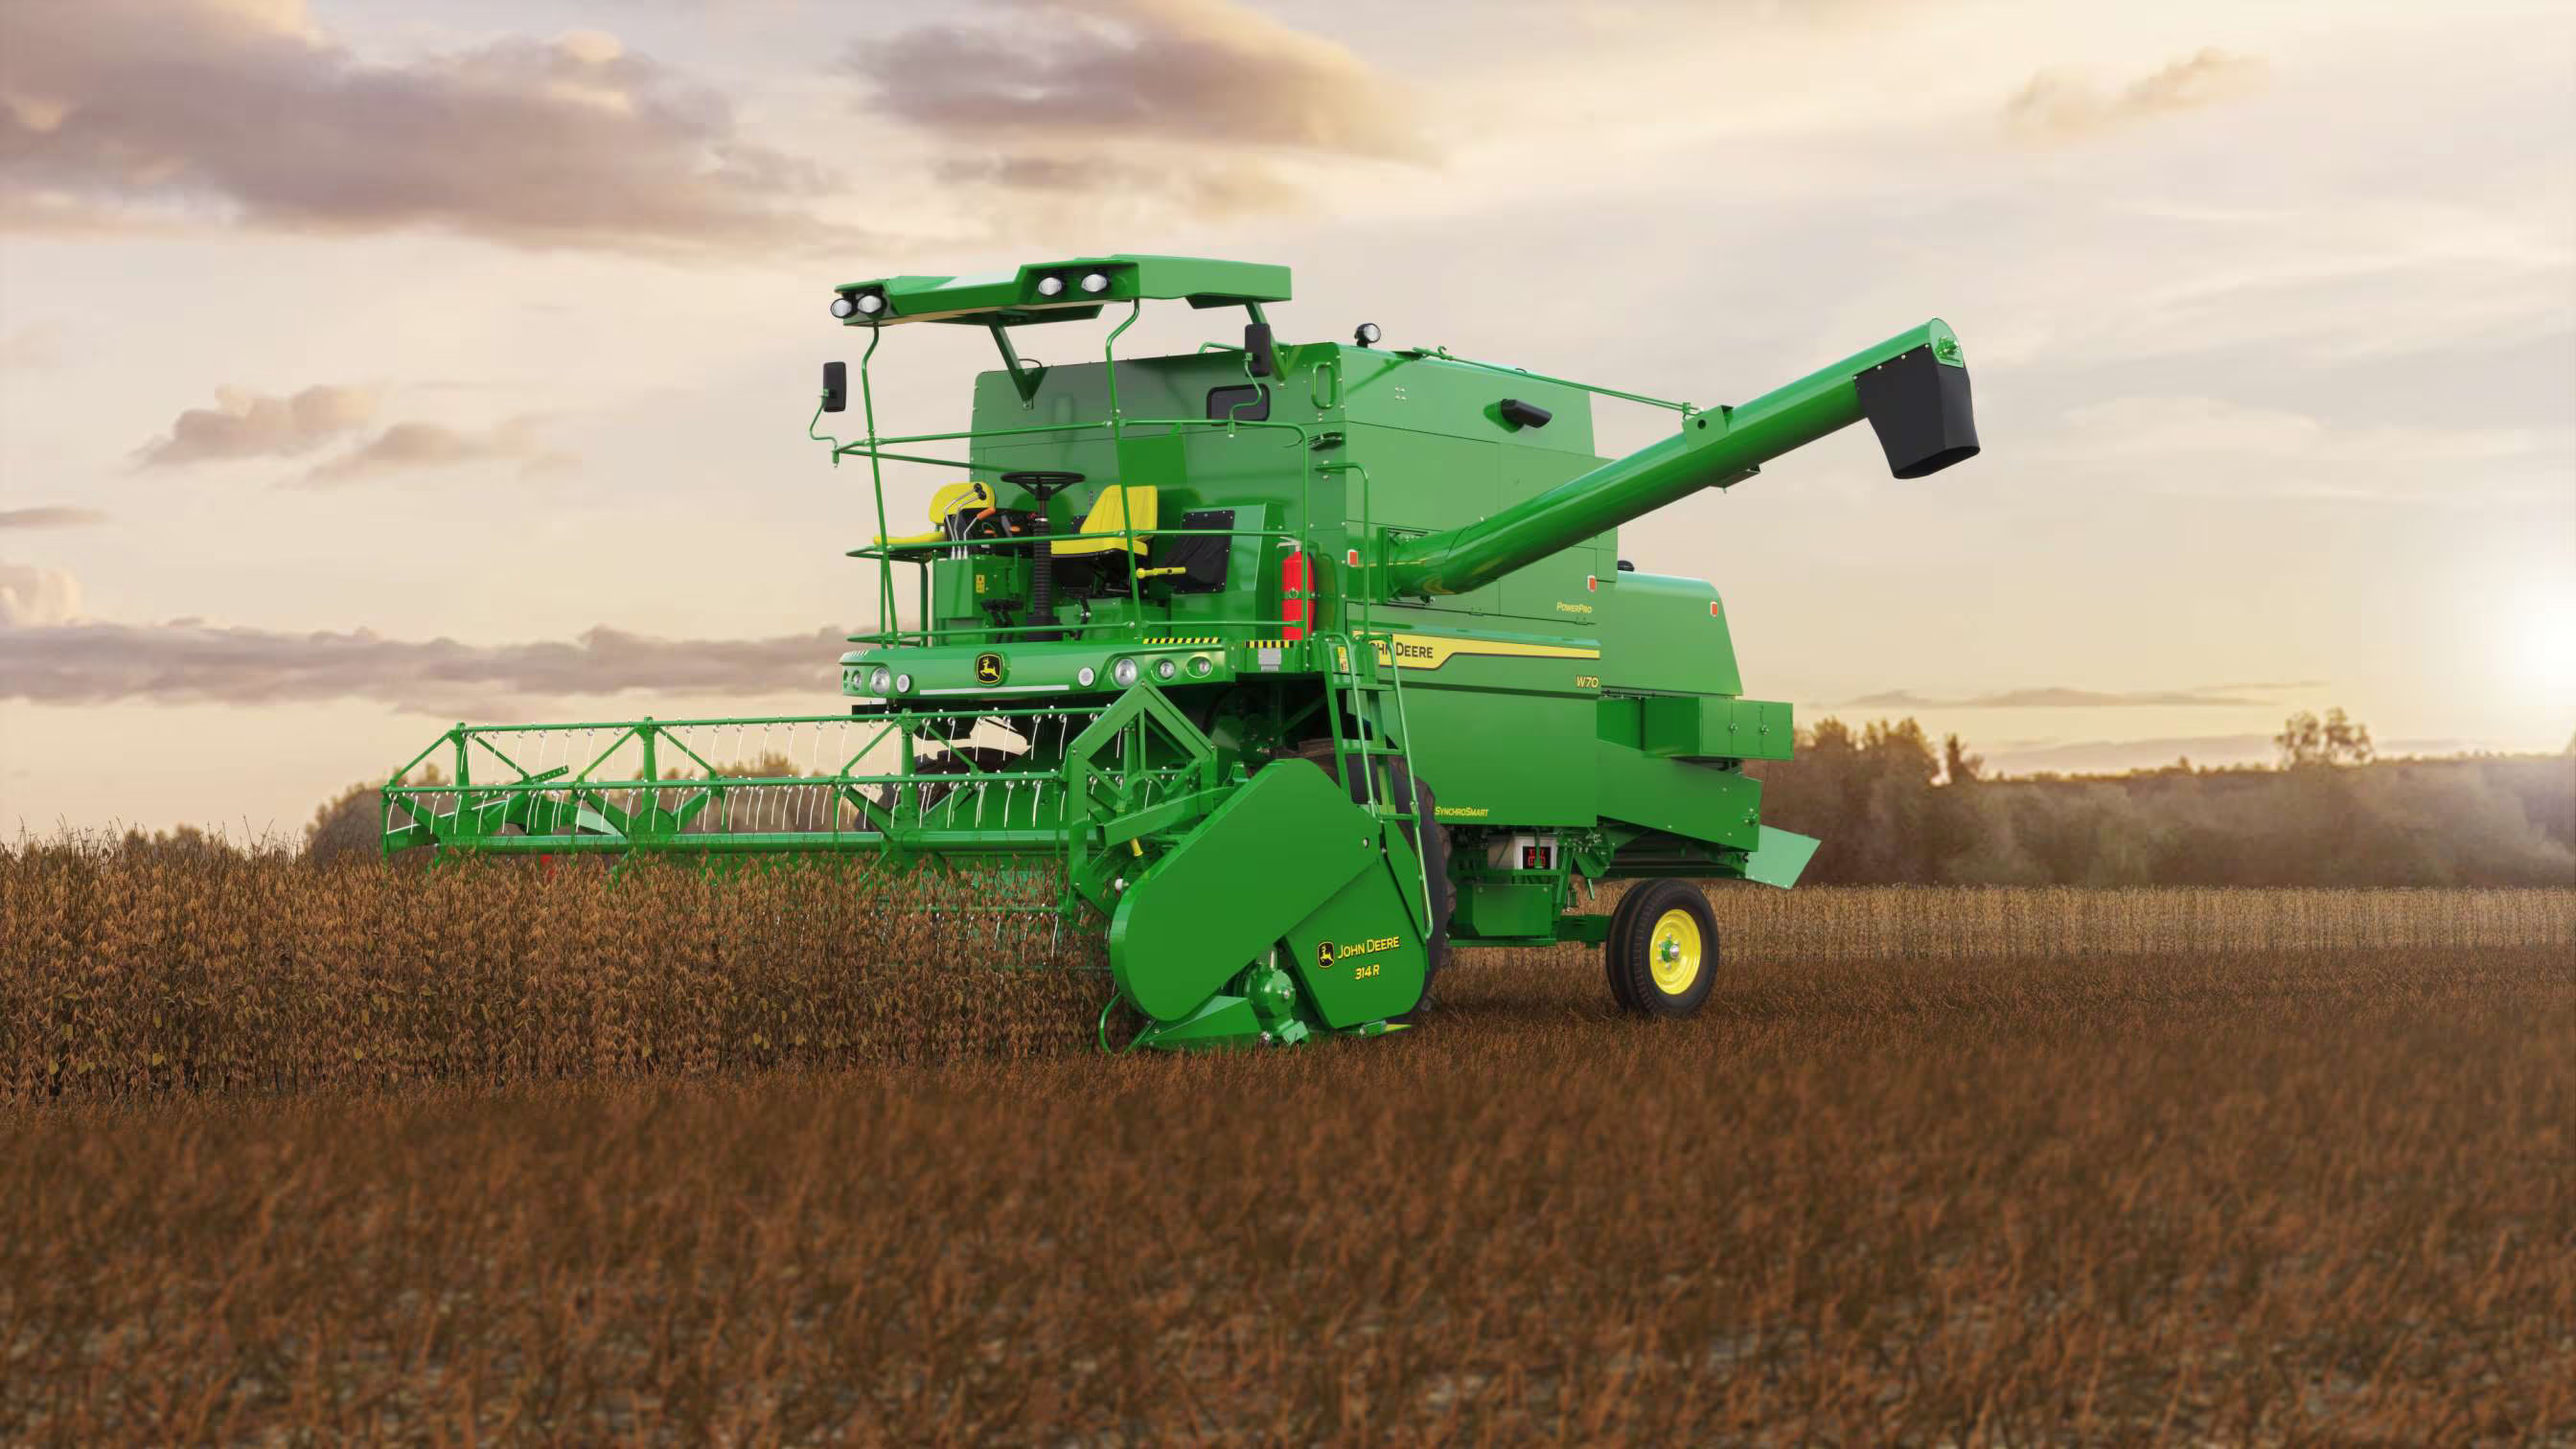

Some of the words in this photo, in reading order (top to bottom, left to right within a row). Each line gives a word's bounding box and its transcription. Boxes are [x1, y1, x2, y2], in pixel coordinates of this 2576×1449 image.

[1395, 641, 1434, 659] DEERE
[1576, 675, 1599, 688] W70
[1338, 944, 1365, 959] JOHN
[1367, 936, 1400, 954] DEERE
